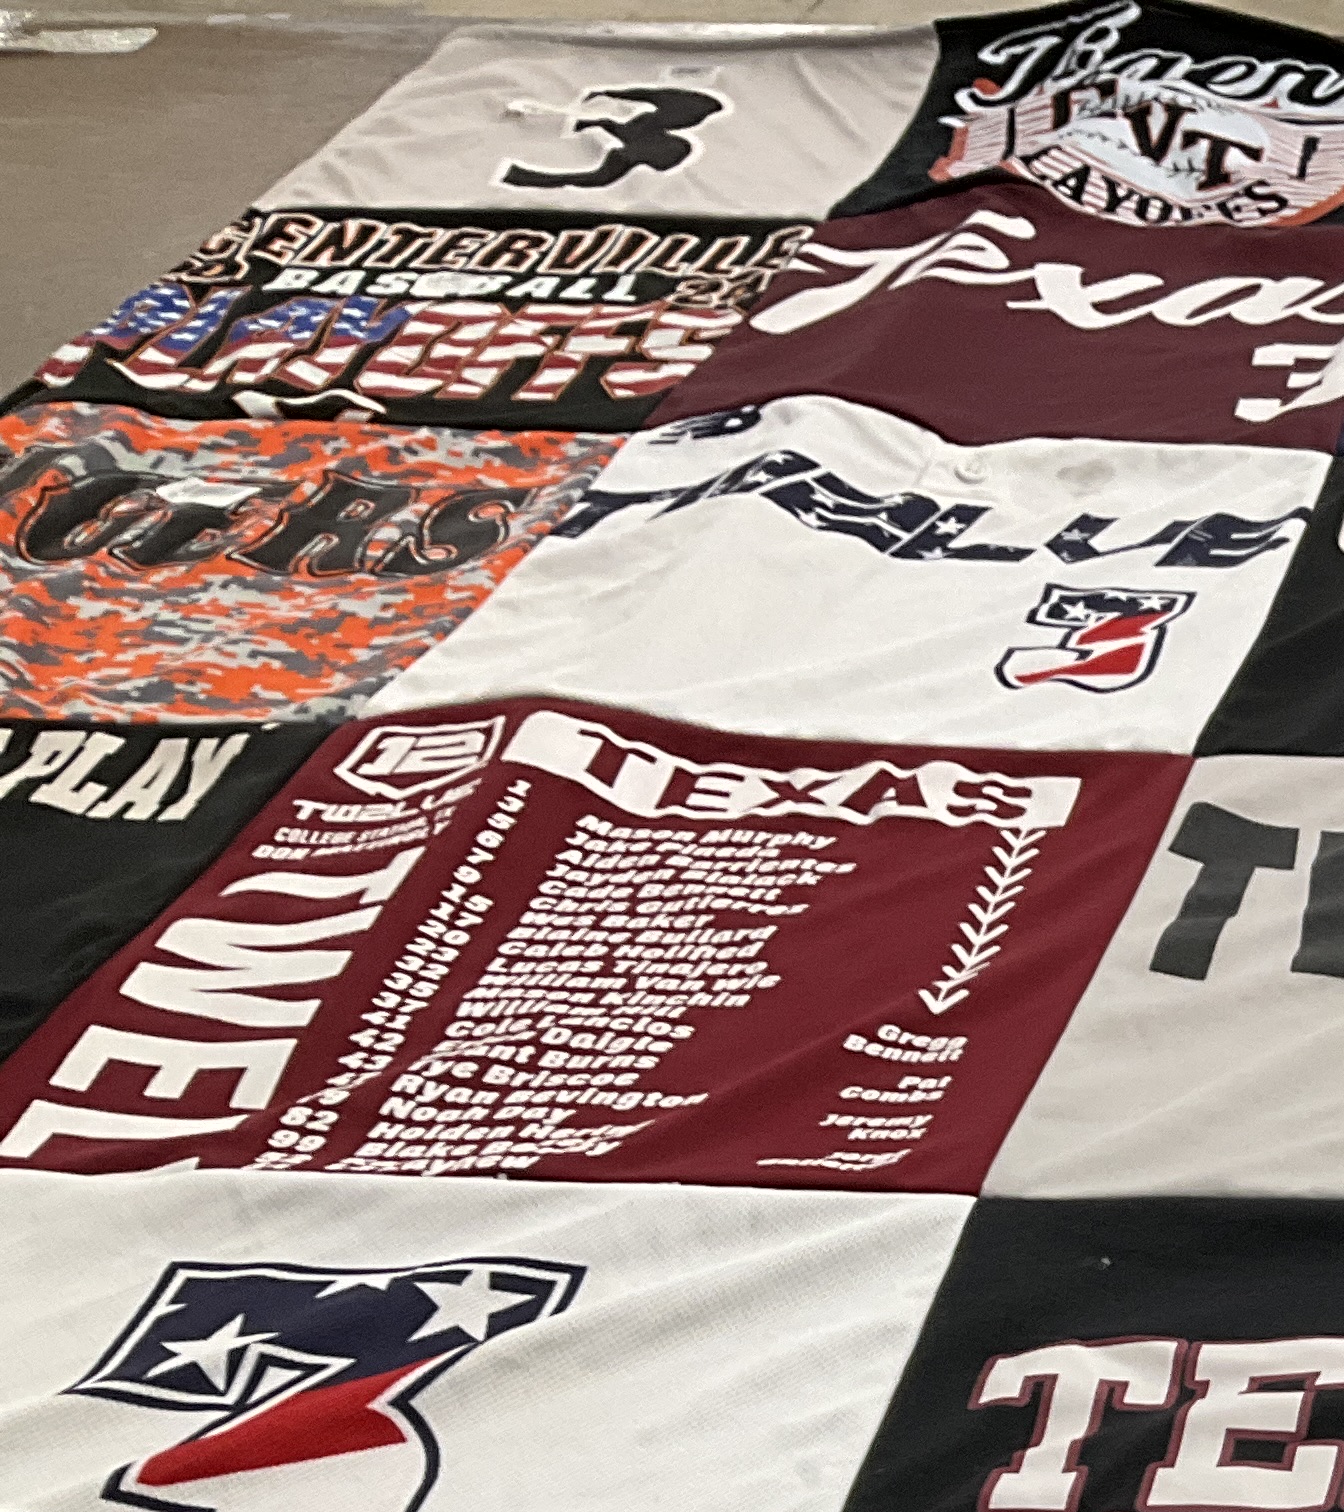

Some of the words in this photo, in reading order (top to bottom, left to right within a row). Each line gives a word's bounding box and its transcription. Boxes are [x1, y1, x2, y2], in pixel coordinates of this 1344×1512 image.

[995, 584, 1197, 692] 3
[356, 730, 486, 776] 12
[28, 731, 250, 821] PLAY
[574, 728, 1036, 815] TEXAS
[476, 830, 505, 848] 6
[576, 814, 697, 840] Mason
[700, 828, 838, 850] Murphy
[453, 865, 482, 884] 9
[635, 924, 778, 945] Bullard
[497, 941, 609, 958] Caleb
[486, 957, 604, 973] Lucas
[383, 972, 440, 998] 35
[477, 973, 628, 989] William
[634, 975, 706, 991] Van
[445, 1018, 533, 1038] Cole
[539, 1026, 675, 1054] Daigle
[537, 1050, 661, 1070] Burns
[481, 1063, 641, 1088] Briscoe
[390, 1073, 500, 1105] Ryan
[503, 1087, 710, 1111] Bevington
[838, 1086, 946, 1103] Combs
[378, 1096, 491, 1121] Noah
[493, 1106, 577, 1126] Day
[267, 1129, 327, 1152] 99
[366, 1121, 516, 1141] Holden
